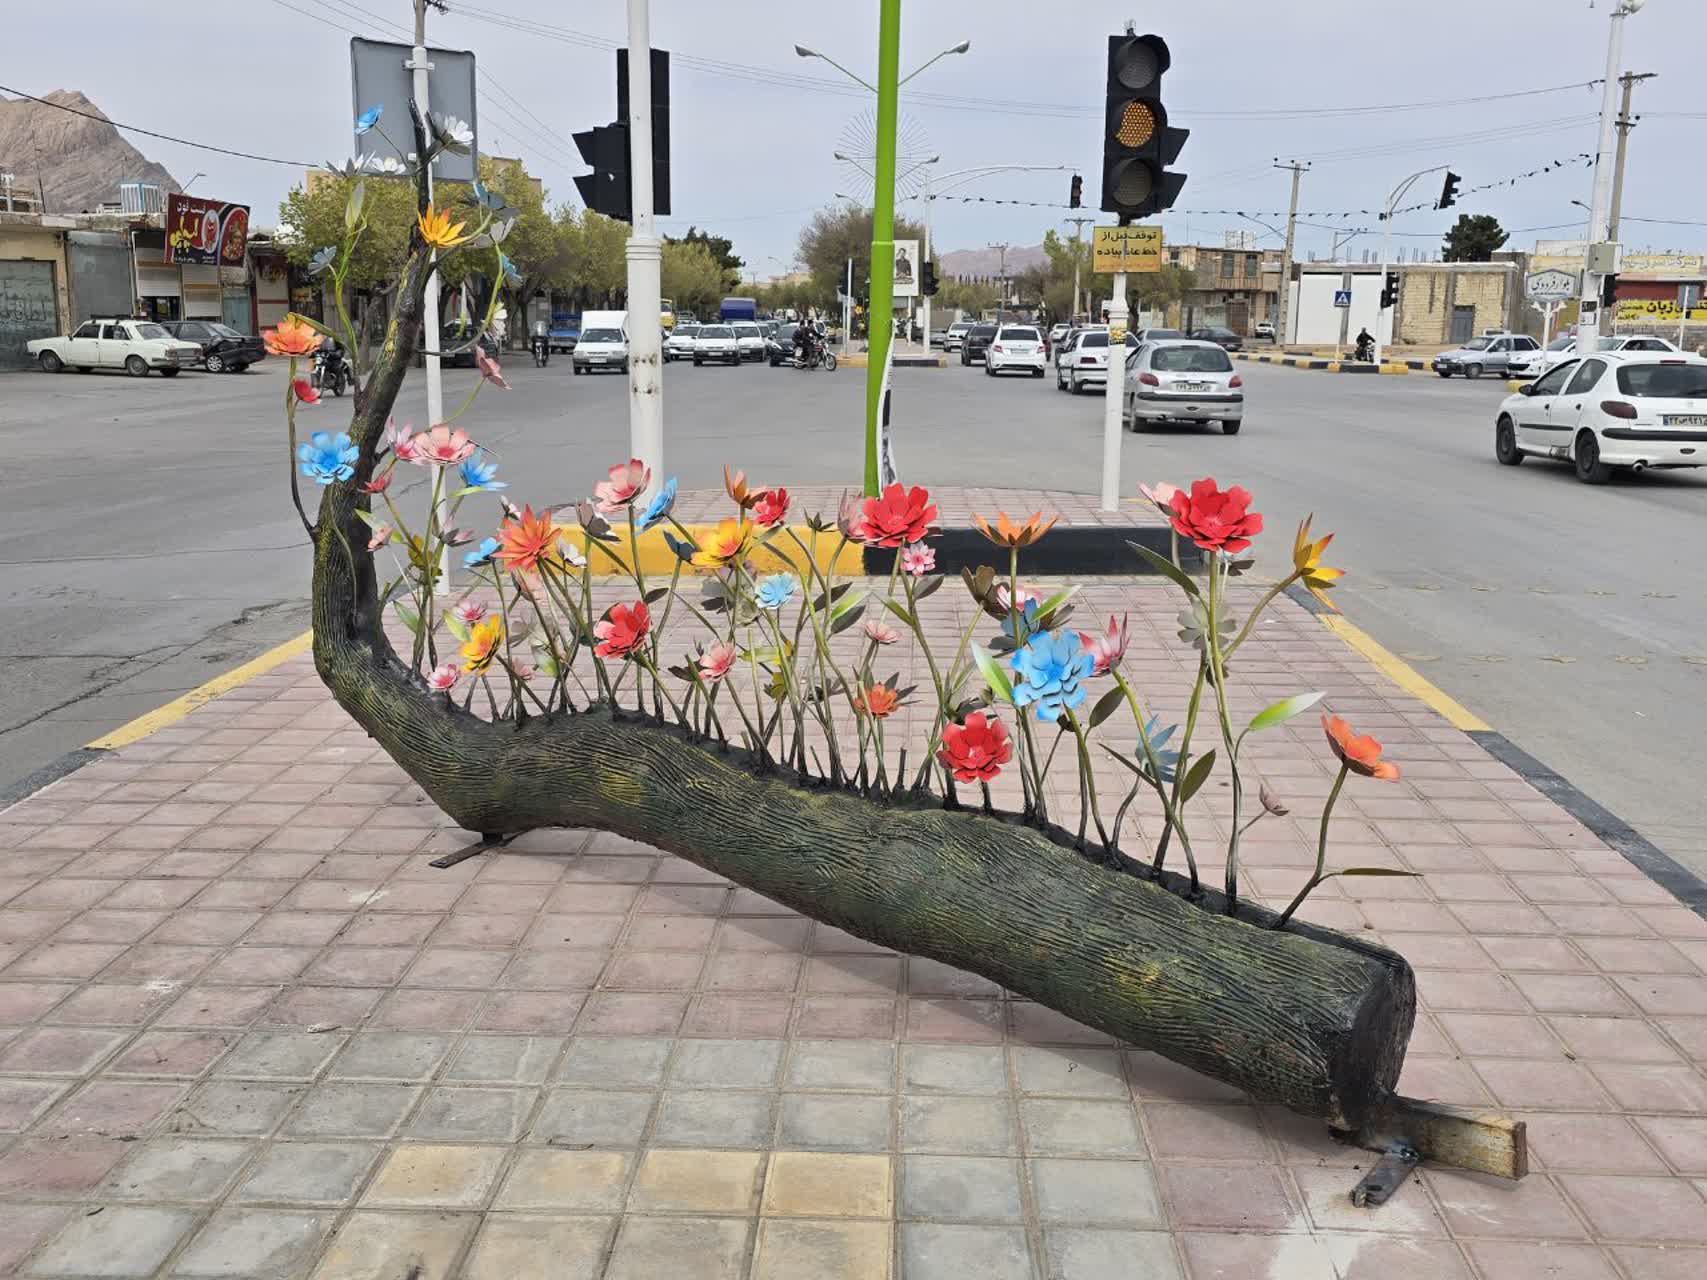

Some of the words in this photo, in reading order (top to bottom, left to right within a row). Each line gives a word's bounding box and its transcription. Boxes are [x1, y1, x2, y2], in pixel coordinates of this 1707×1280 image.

[1101, 231, 1111, 242] از
[1111, 231, 1128, 242] قبل
[1128, 231, 1157, 242] توقف
[1097, 248, 1122, 259] پیاده
[1141, 248, 1158, 256] خط
[1646, 300, 1674, 315] زبان
